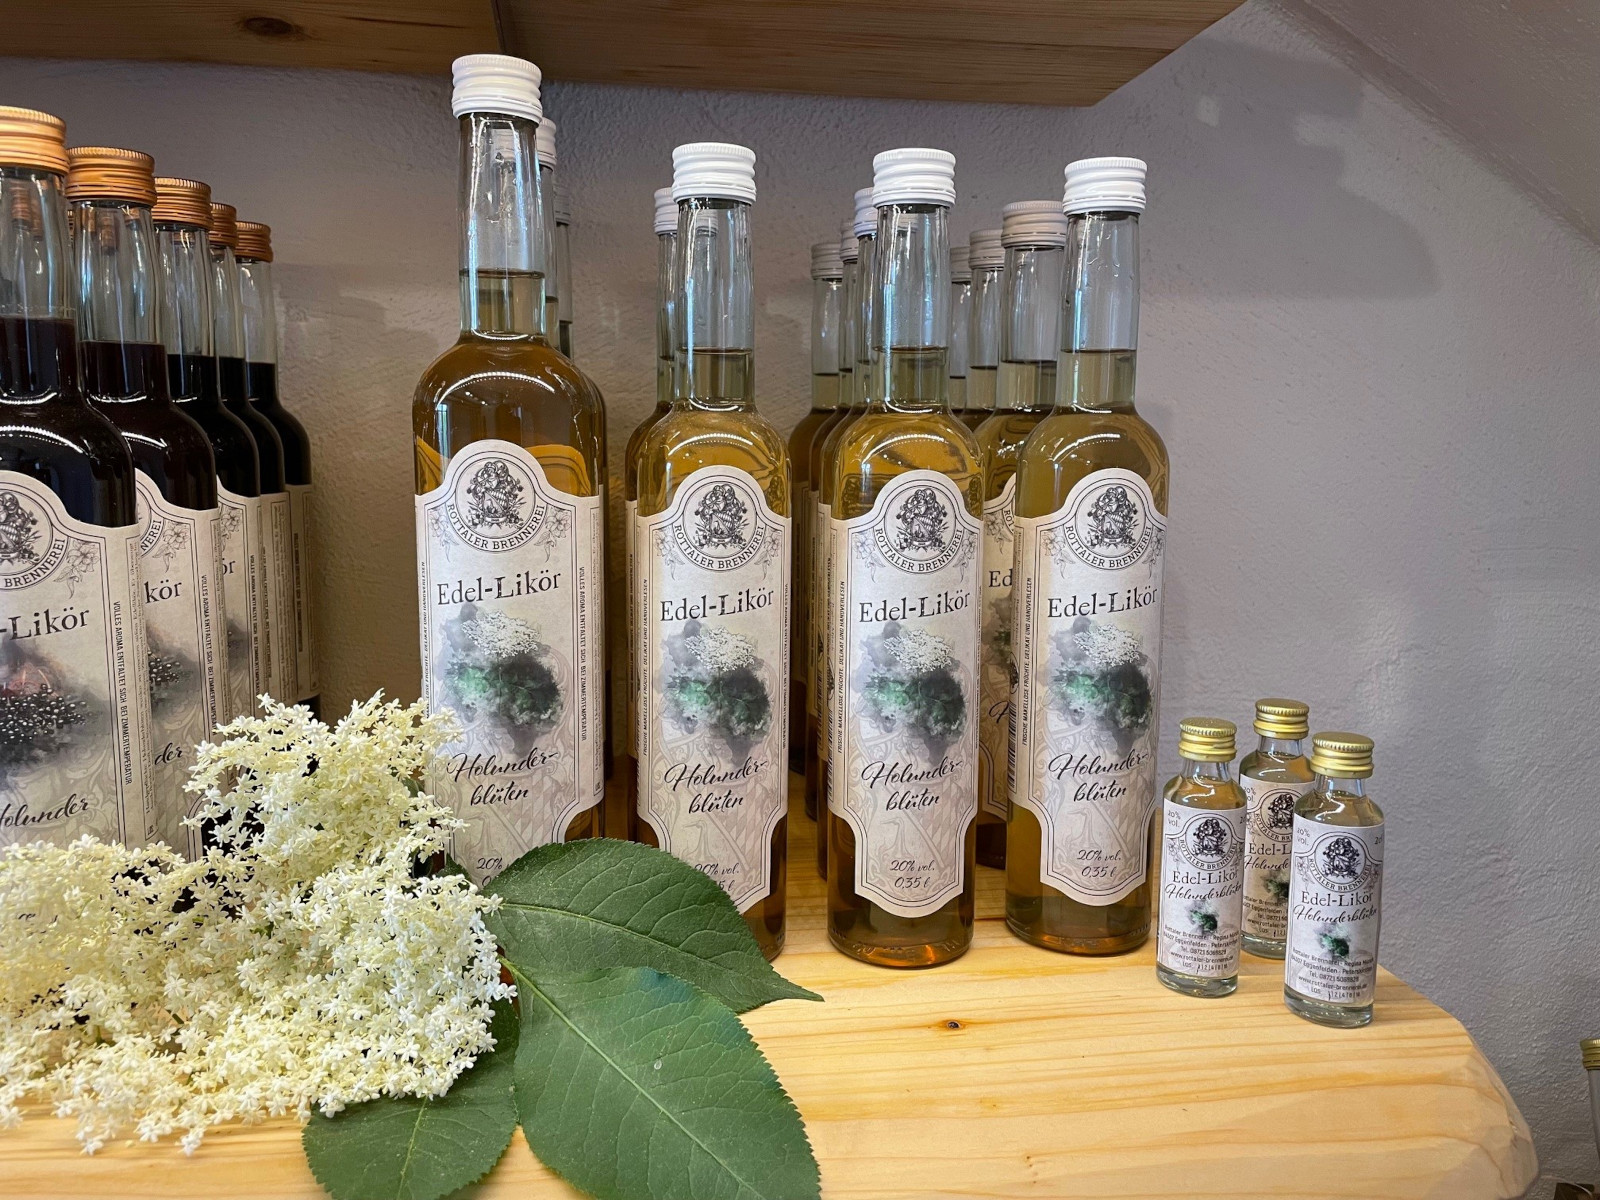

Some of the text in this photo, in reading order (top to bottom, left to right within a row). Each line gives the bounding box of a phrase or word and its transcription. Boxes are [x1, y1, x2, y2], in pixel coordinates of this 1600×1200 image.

[447, 503, 545, 550] ROTTALER BRENNEREI
[4, 538, 66, 588] BRENNEREI
[674, 524, 764, 569] ROTTALER BRENNEREI
[875, 527, 963, 572] ROTTALER BRENNEREI
[1065, 525, 1151, 568] ROTTALER BRENNEREI
[201, 575, 209, 596] VOLLES
[437, 569, 561, 605] Edel-Likör
[1024, 577, 1032, 622] HANDVERLESEN
[1048, 585, 1158, 618] Edel-Likör
[660, 587, 774, 622] Edel-Likör
[859, 589, 971, 623] Edel-Likör
[204, 619, 212, 649] ENTFALTET
[113, 601, 133, 786] VOLLES AROMA ENTFALTET SICH BEI ZIMMERTEMPERATUR
[580, 677, 588, 741] ZIMMERTEMPERATUR
[446, 747, 558, 782] Holunder-
[663, 756, 768, 791] Holunder-
[861, 755, 963, 789] Holunder-
[1048, 748, 1149, 781] Holunder-
[470, 781, 528, 806] blüten
[688, 789, 744, 814] blüten
[886, 787, 940, 811] blüten
[1073, 779, 1127, 802] blüten
[476, 857, 503, 870] 20%
[721, 862, 740, 875] vol.
[890, 859, 935, 872] 20% vol.
[1077, 849, 1121, 861] 20% vol.
[1179, 839, 1237, 869] ROTTALER BRENNEREI
[894, 876, 921, 889] 0,35
[1081, 865, 1107, 878] 0,35
[1172, 867, 1239, 885] Edel-Likör
[1309, 858, 1372, 891] ROTTALER BRENNEREI
[1301, 891, 1374, 907] Edel-Likör
